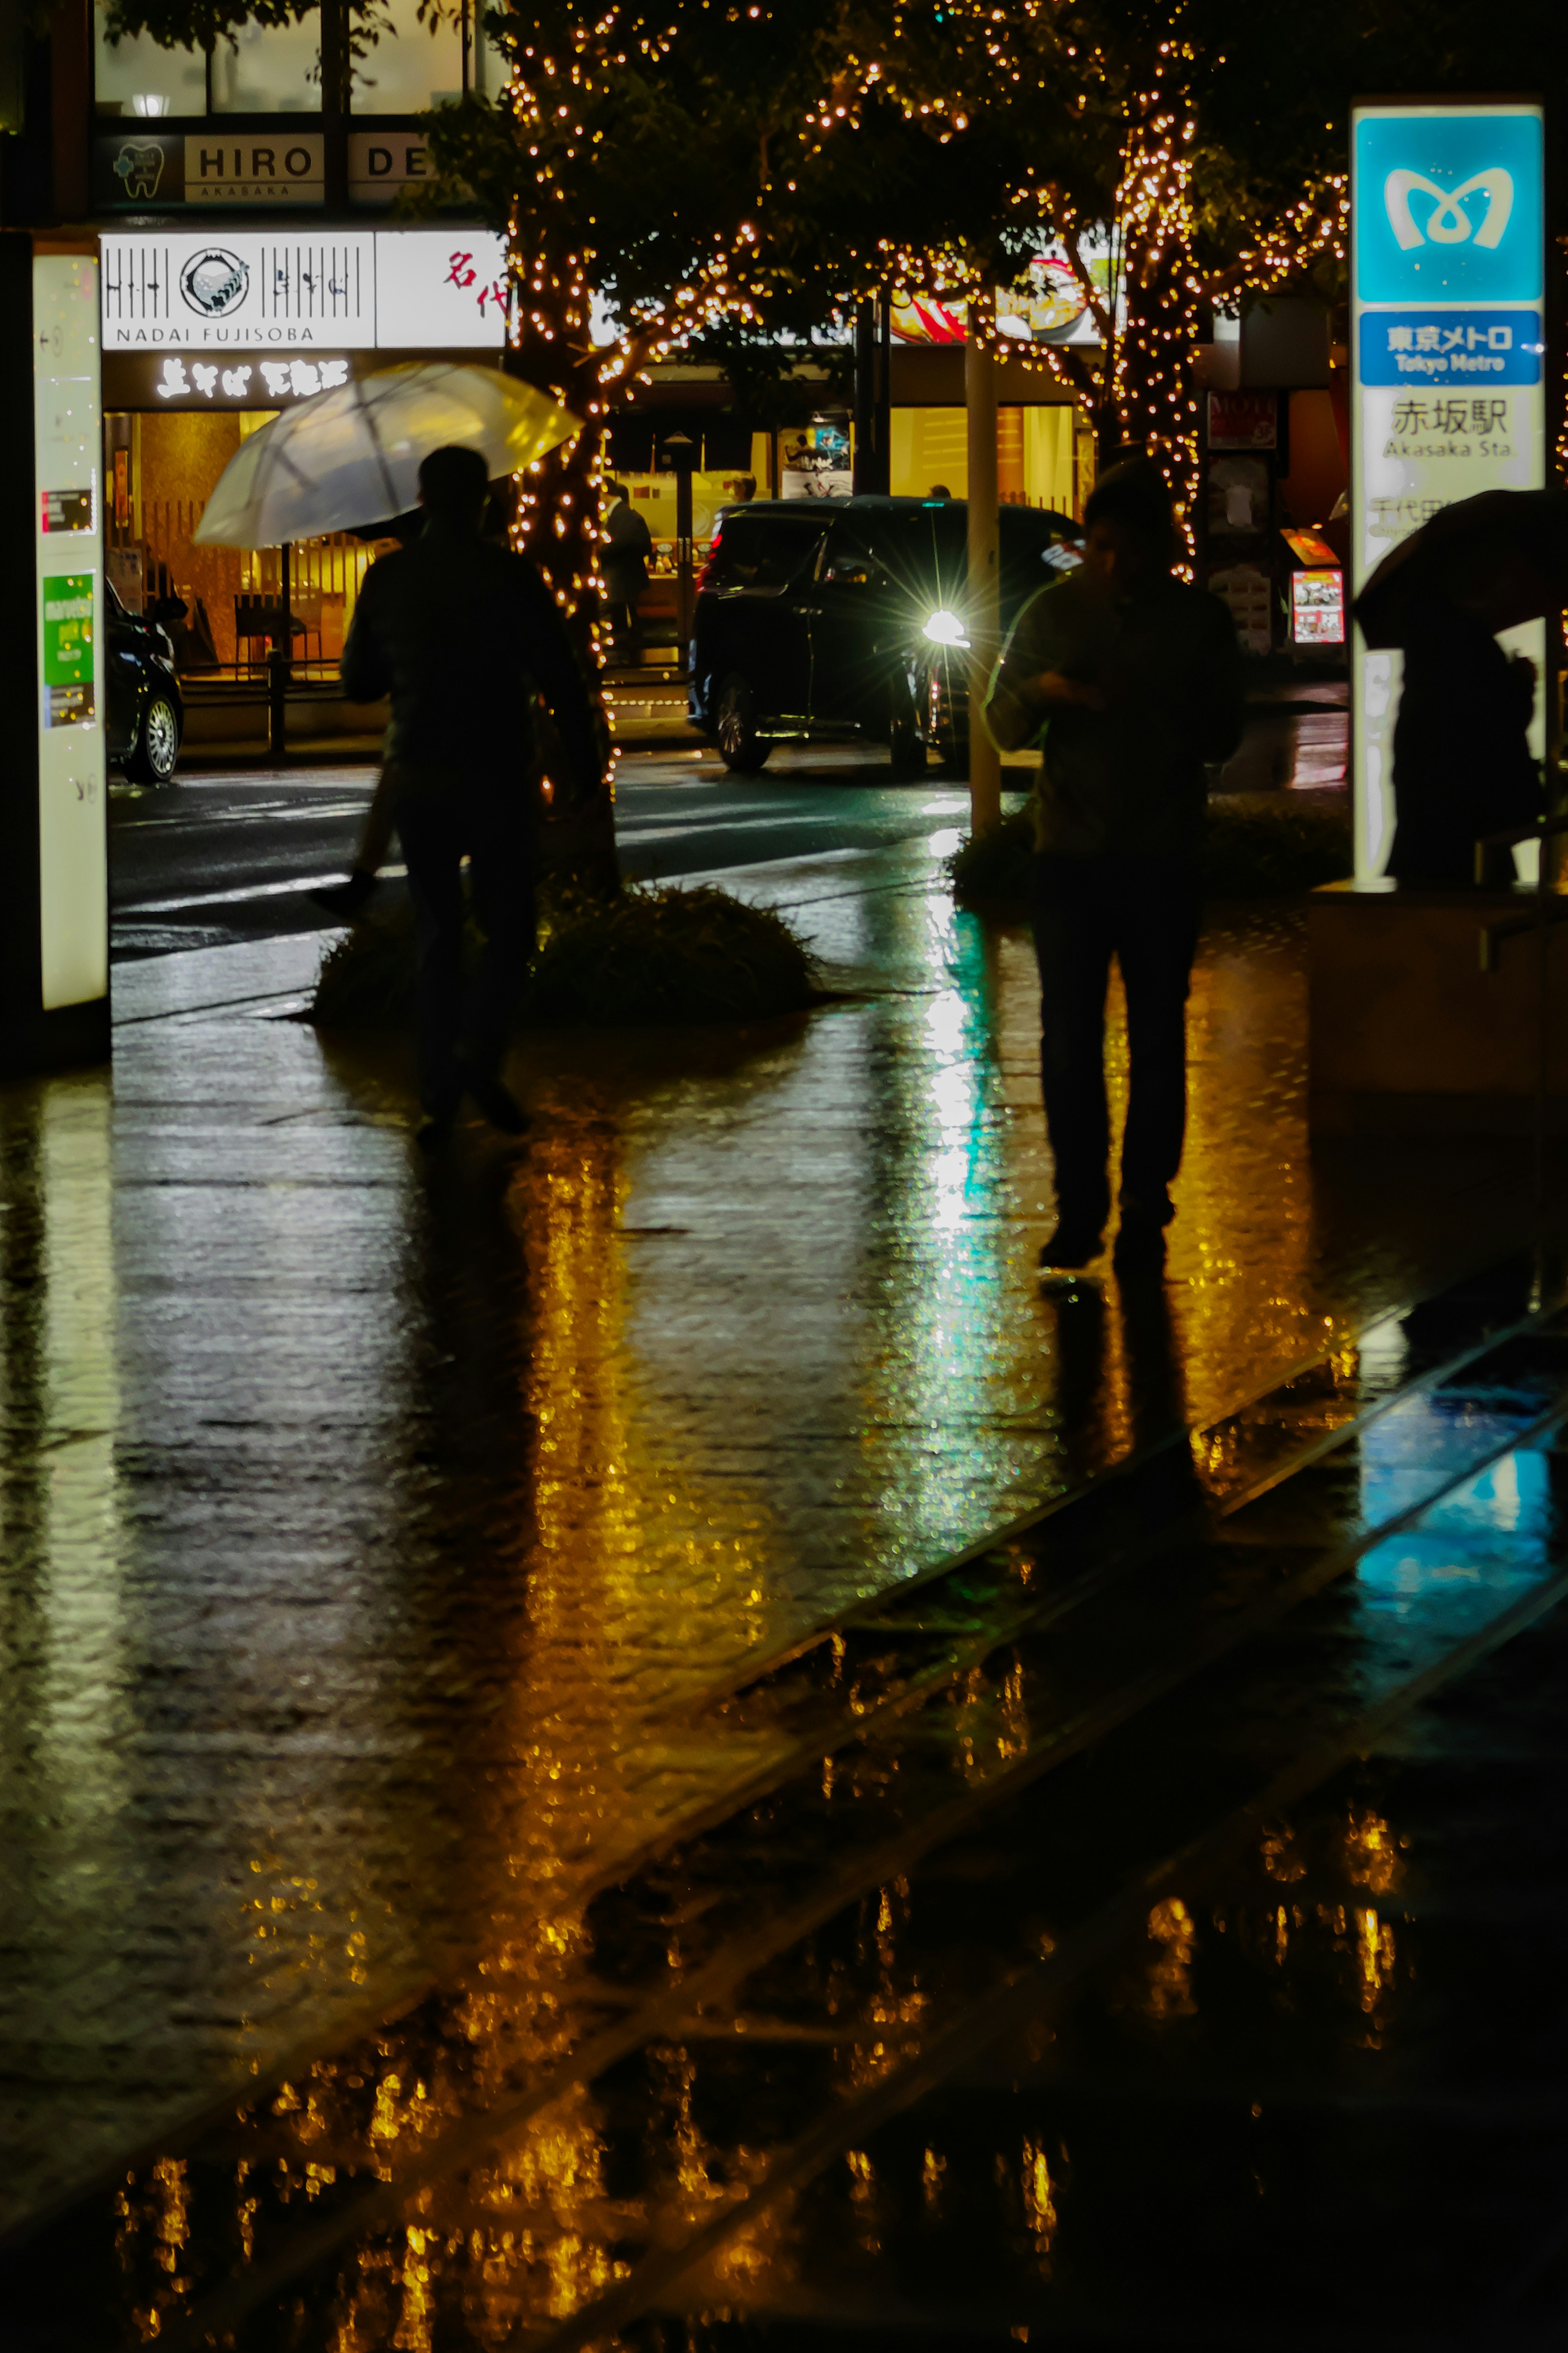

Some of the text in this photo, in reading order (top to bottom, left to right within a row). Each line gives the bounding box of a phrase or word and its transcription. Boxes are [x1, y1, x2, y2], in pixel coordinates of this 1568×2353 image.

[200, 147, 312, 177] HIRO
[117, 328, 314, 342] NADAI FUJISOBA
[1387, 326, 1513, 352] 東京メトロ
[1394, 353, 1506, 375] Tokyo Metro
[1394, 399, 1508, 435] 赤坂駅
[1385, 440, 1471, 457] Akasaka
[1372, 499, 1453, 522] 千代田
